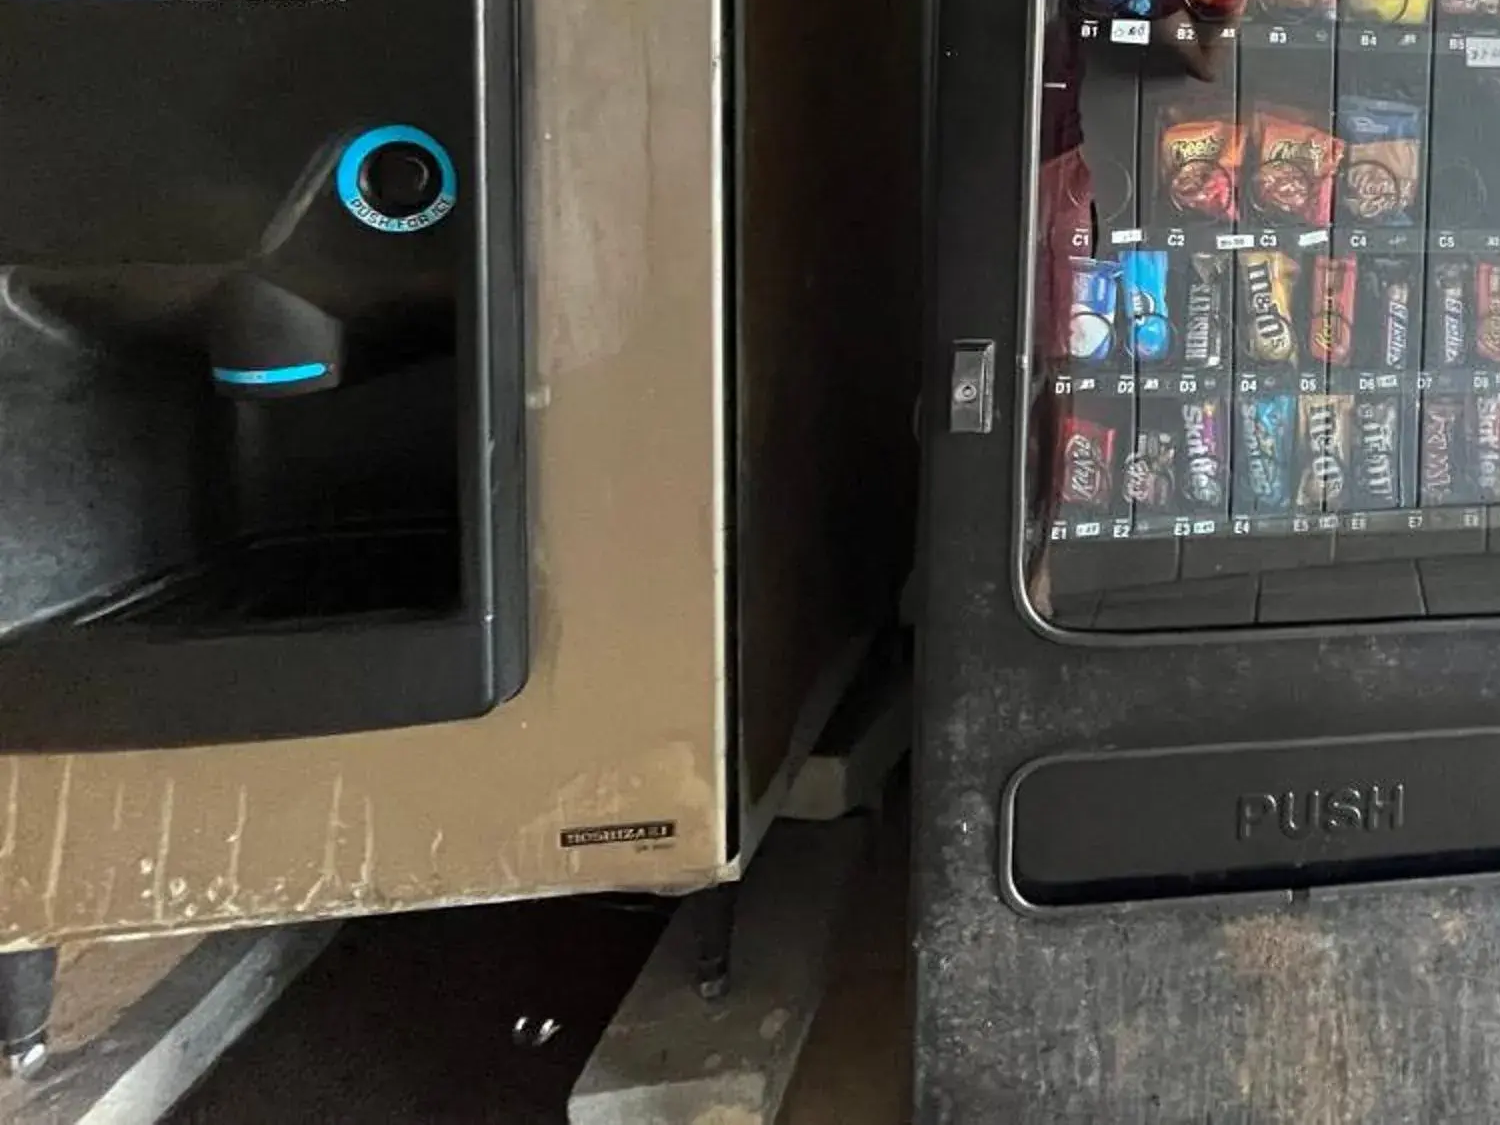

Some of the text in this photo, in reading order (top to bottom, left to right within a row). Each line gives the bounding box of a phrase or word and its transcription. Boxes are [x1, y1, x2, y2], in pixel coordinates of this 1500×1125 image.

[350, 197, 389, 228] PUSH
[396, 215, 429, 229] FOR
[1168, 235, 1184, 246] C2
[1351, 236, 1367, 247] C4
[1055, 382, 1071, 394] D1
[1117, 381, 1134, 393] D2
[1180, 381, 1197, 392] D3
[1240, 379, 1257, 391] D4
[1051, 528, 1067, 540] E1
[1113, 526, 1129, 537] E2
[1236, 784, 1405, 840] PUSH
